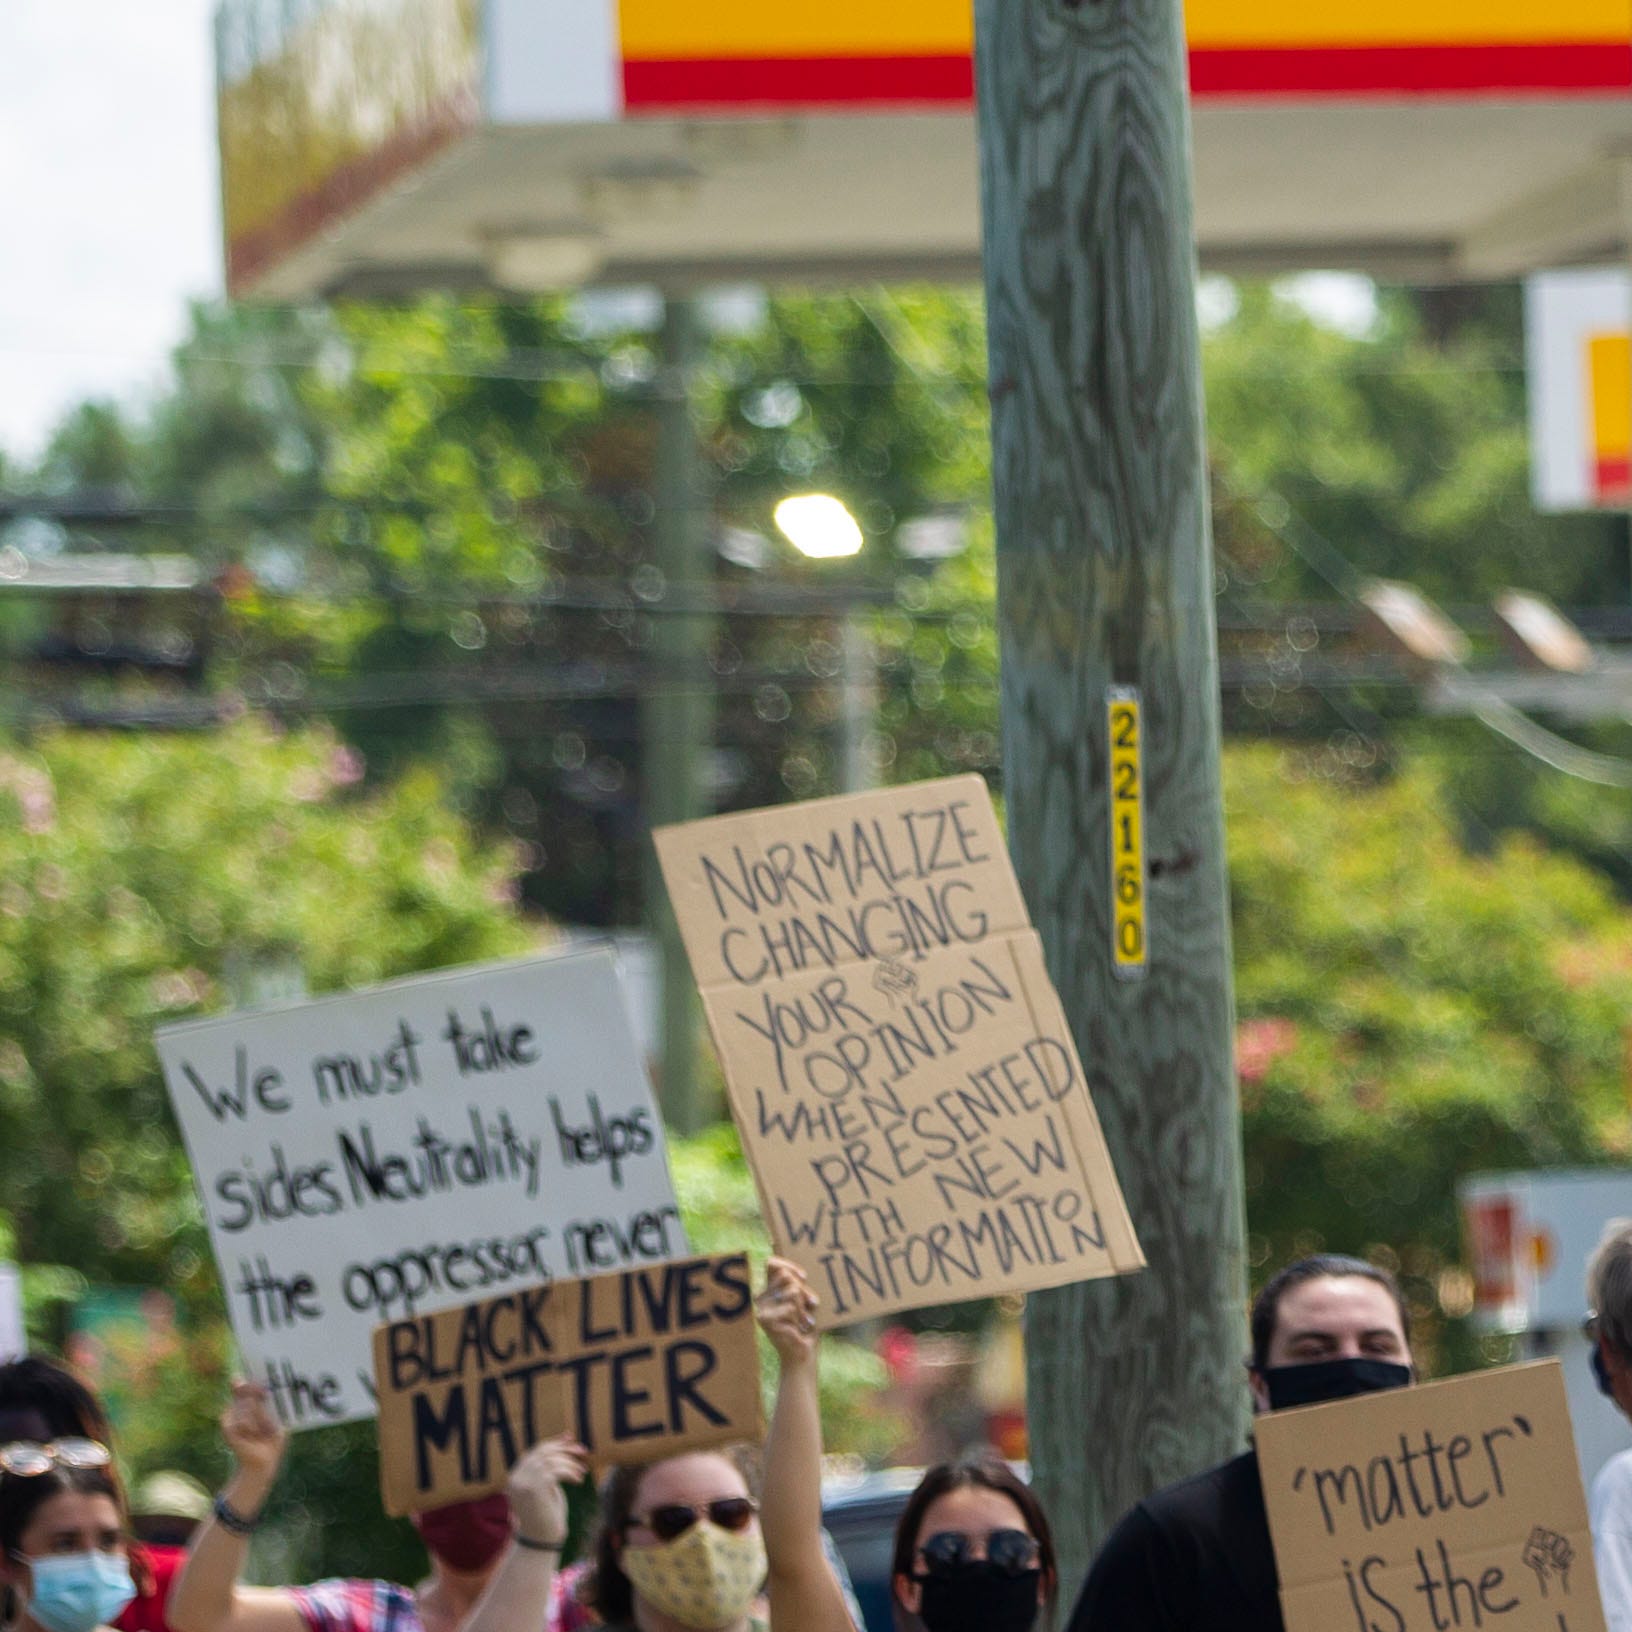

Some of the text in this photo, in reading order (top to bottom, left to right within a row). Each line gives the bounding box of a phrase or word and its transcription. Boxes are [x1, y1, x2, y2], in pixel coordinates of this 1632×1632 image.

[701, 802, 991, 920] NORMALIZE
[1112, 709, 1145, 959] 22160
[720, 881, 989, 987] CHANGING
[181, 1004, 540, 1126] We must take
[737, 976, 873, 1095] YOUR
[803, 957, 1013, 1100] OPINION
[216, 1093, 654, 1233] sides Neutrality helps
[756, 1082, 908, 1142] WHEN
[810, 1036, 1078, 1202] PRESENTED
[775, 1115, 1069, 1253] WITH NEW
[236, 1206, 679, 1335] the oppressor never
[819, 1188, 1109, 1316] INFORMATION
[387, 1256, 753, 1391] BLACK LIVES
[265, 1360, 342, 1420] the
[411, 1339, 731, 1494] MATTER
[1417, 1540, 1521, 1632] the
